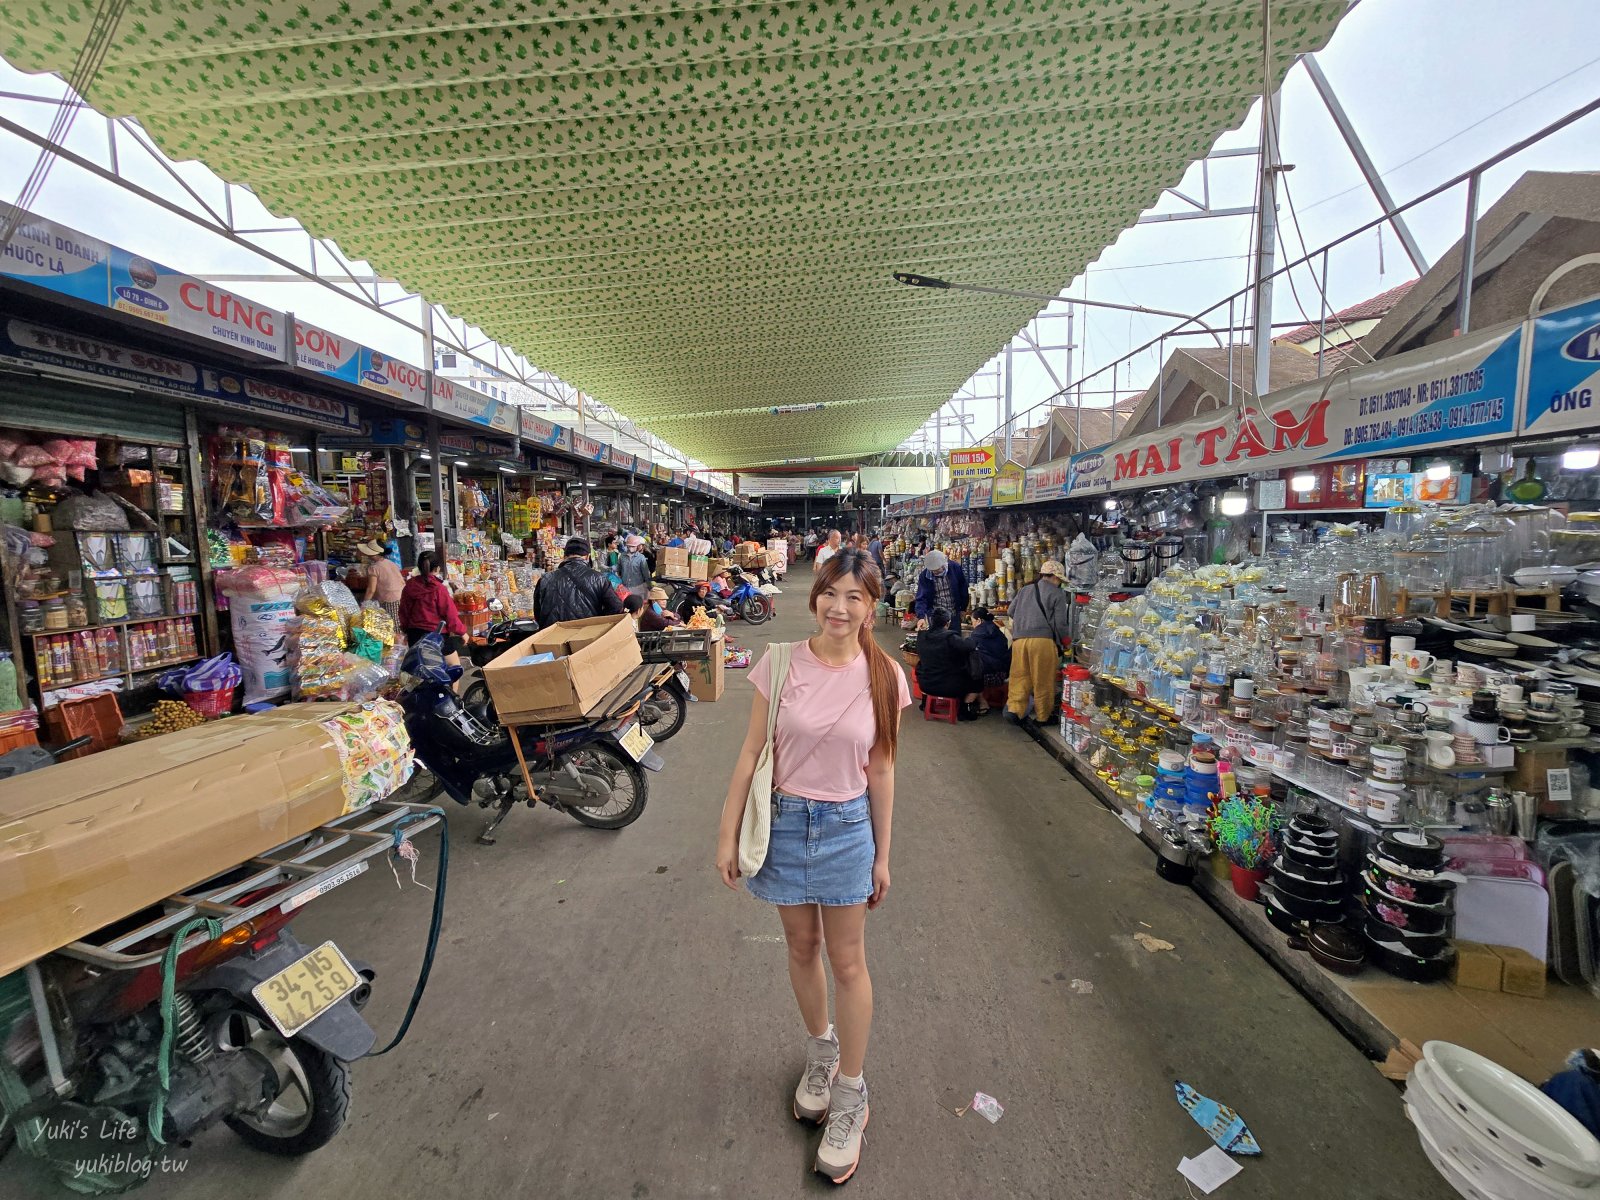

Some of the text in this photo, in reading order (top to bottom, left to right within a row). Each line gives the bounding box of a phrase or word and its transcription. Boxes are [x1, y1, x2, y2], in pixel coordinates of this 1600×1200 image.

[19, 223, 50, 247] KINH
[55, 236, 99, 263] DOANH
[49, 257, 65, 274] LÁ
[179, 282, 274, 337] CƯNG
[240, 334, 255, 347] KINH
[256, 339, 277, 354] DOANH
[295, 323, 340, 360] SƠN
[387, 361, 427, 392] NGỌC
[432, 378, 454, 400] LAN
[1550, 389, 1592, 414] ÔNG
[952, 453, 986, 464] ĐÌNH 15A
[1113, 400, 1331, 481] MAI TÂM
[268, 950, 333, 1002] 34-N5
